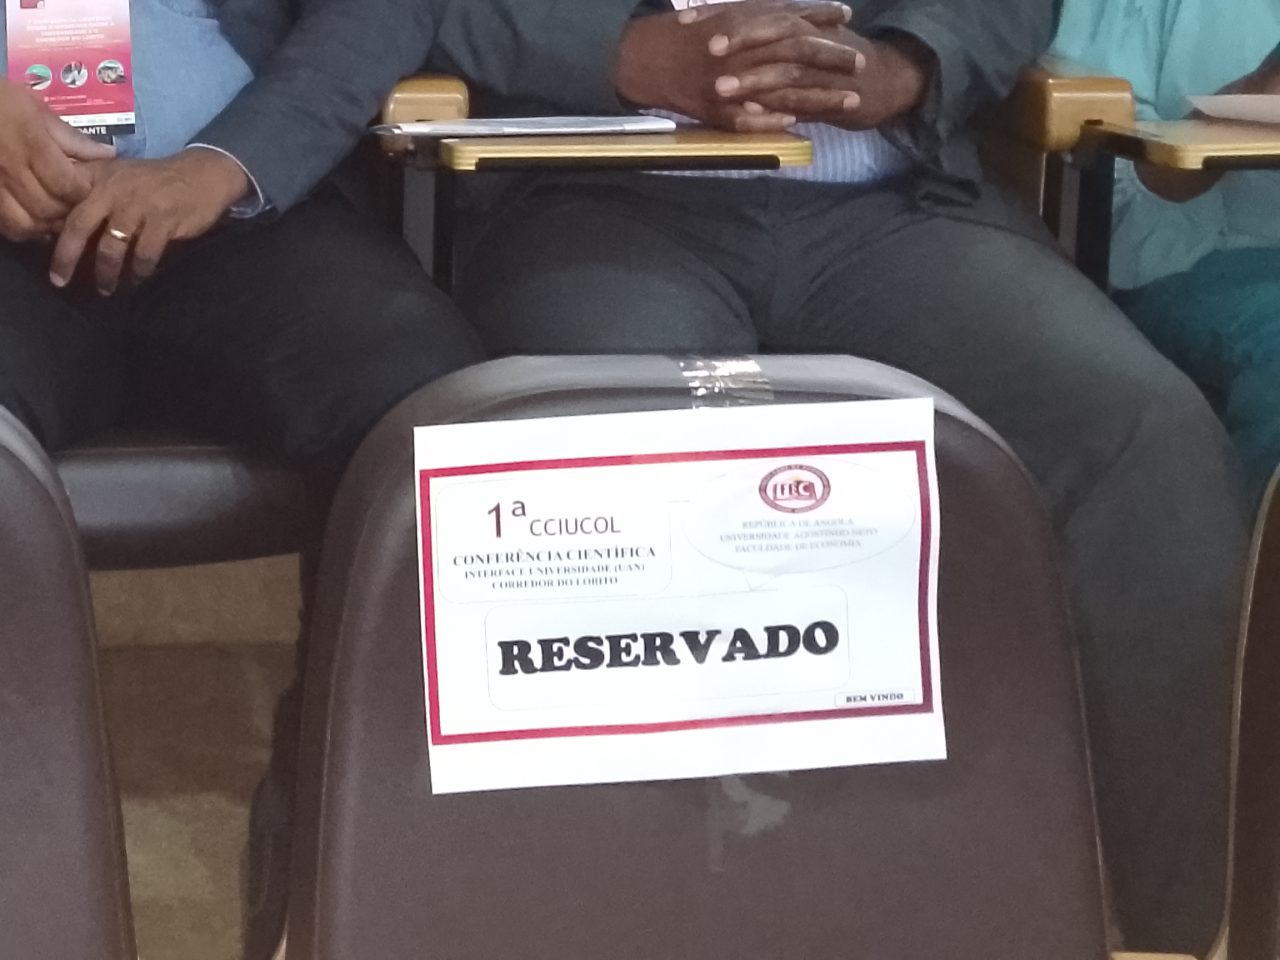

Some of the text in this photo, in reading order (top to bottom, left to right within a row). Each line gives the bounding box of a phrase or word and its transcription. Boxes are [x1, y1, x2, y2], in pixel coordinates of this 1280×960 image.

[529, 516, 622, 536] CCIUCOL
[453, 544, 656, 567] CONFERÊNCIA CIENTÍFICA
[498, 620, 840, 676] RESERVADO
[846, 691, 904, 704] BEM VINDO
